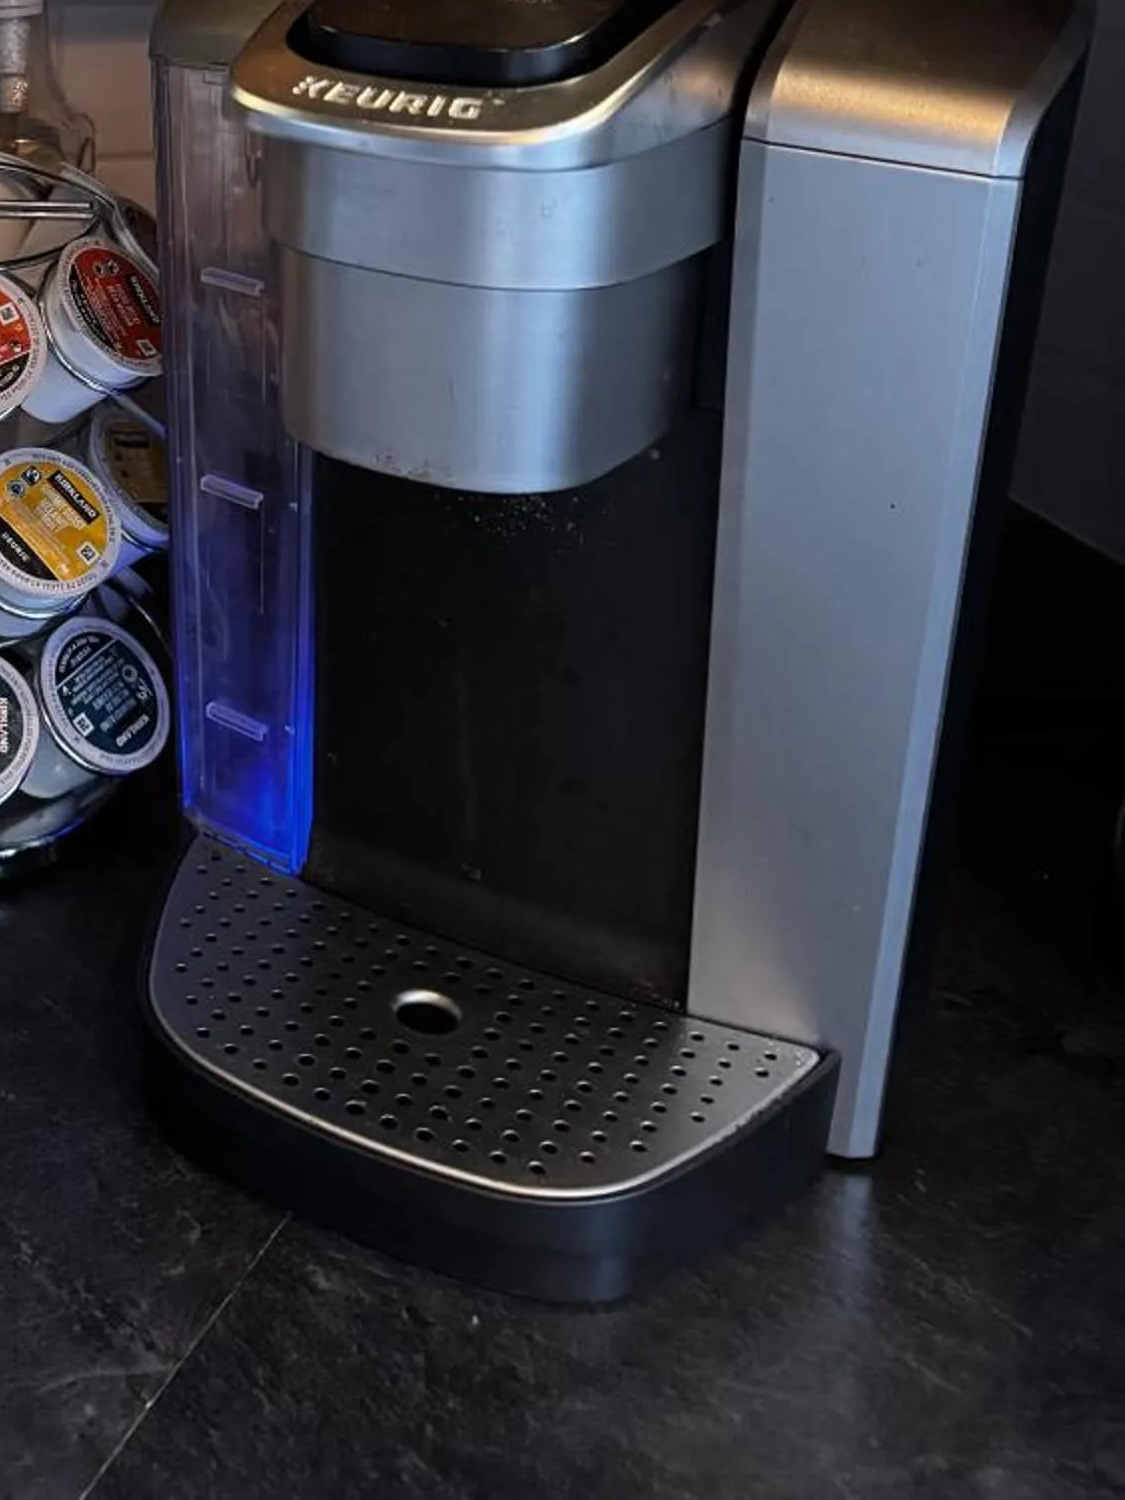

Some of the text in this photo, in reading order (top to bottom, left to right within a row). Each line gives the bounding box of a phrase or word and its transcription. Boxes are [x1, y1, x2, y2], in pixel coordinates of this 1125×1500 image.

[292, 75, 482, 119] KEURIG
[52, 472, 97, 518] KIRKLAND
[116, 714, 150, 747] KIRKLAND
